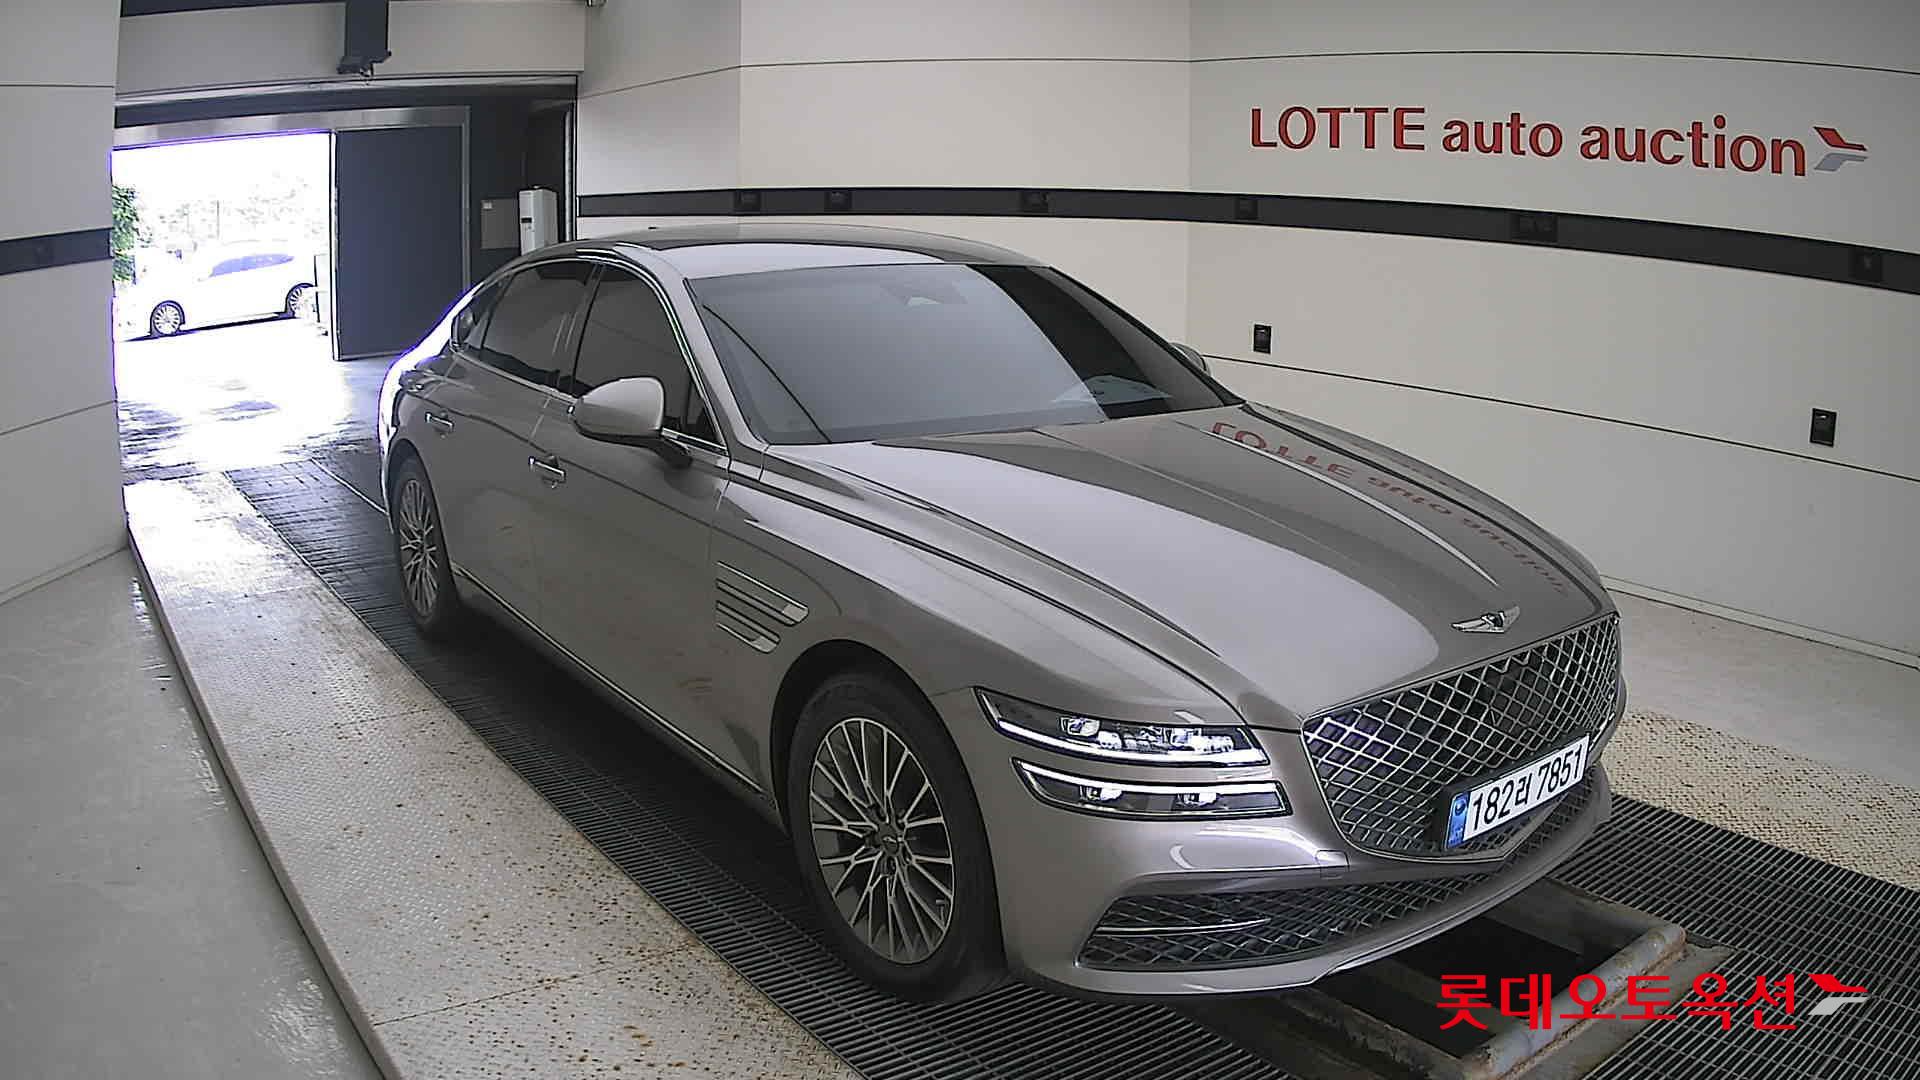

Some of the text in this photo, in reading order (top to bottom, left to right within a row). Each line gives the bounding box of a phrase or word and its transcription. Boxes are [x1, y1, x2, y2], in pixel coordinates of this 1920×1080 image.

[1251, 107, 1806, 177] LOTTE auto auction
[1473, 743, 1583, 831] 182러 7851
